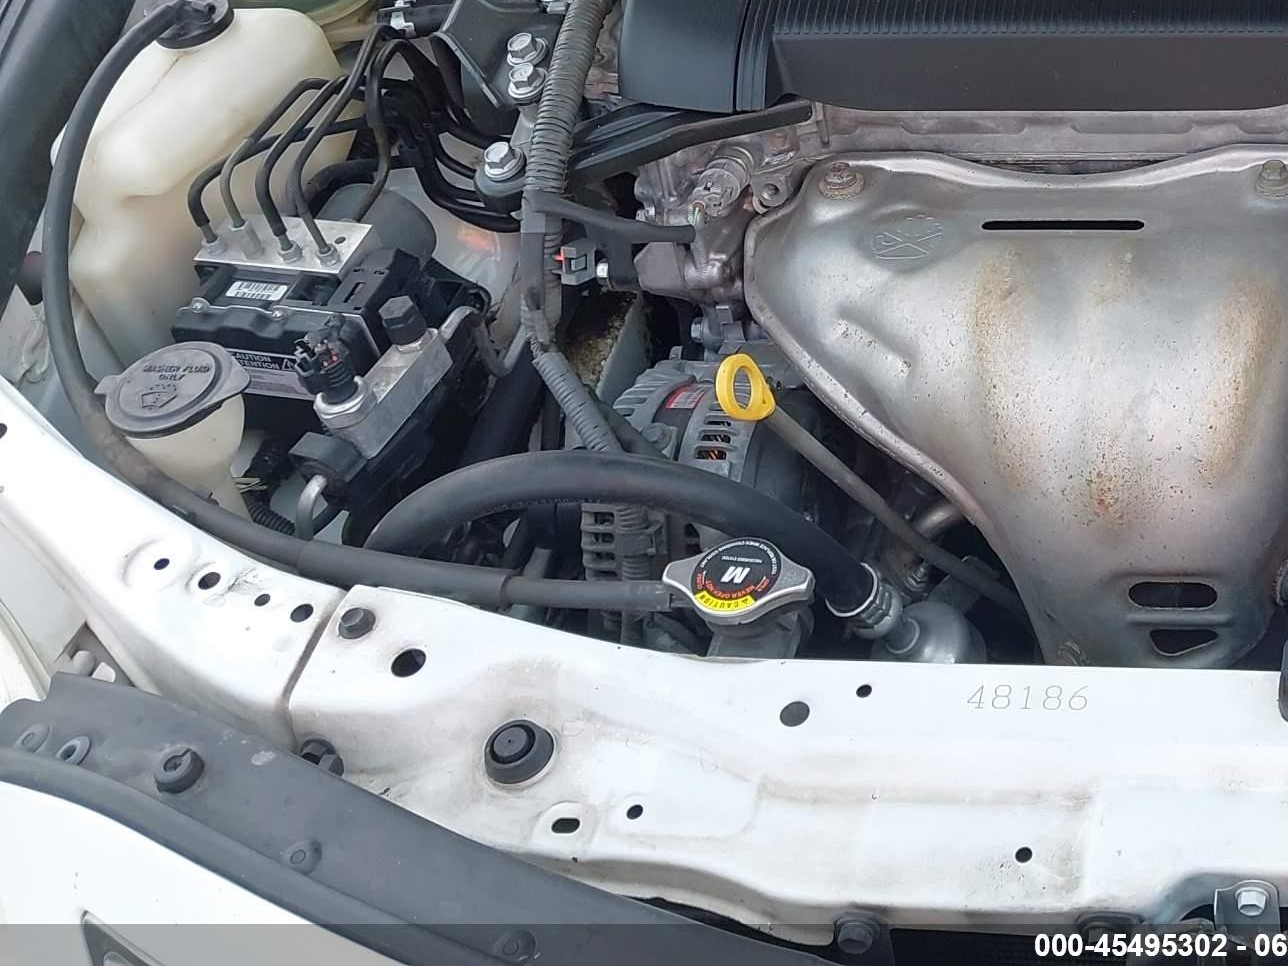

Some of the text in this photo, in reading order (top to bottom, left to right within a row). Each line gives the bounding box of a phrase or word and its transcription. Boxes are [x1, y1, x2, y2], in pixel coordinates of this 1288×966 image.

[158, 372, 186, 381] ONLY
[182, 364, 210, 373] FLUID
[720, 566, 750, 584] M
[699, 593, 739, 609] CAUTION
[966, 684, 1089, 711] 48186
